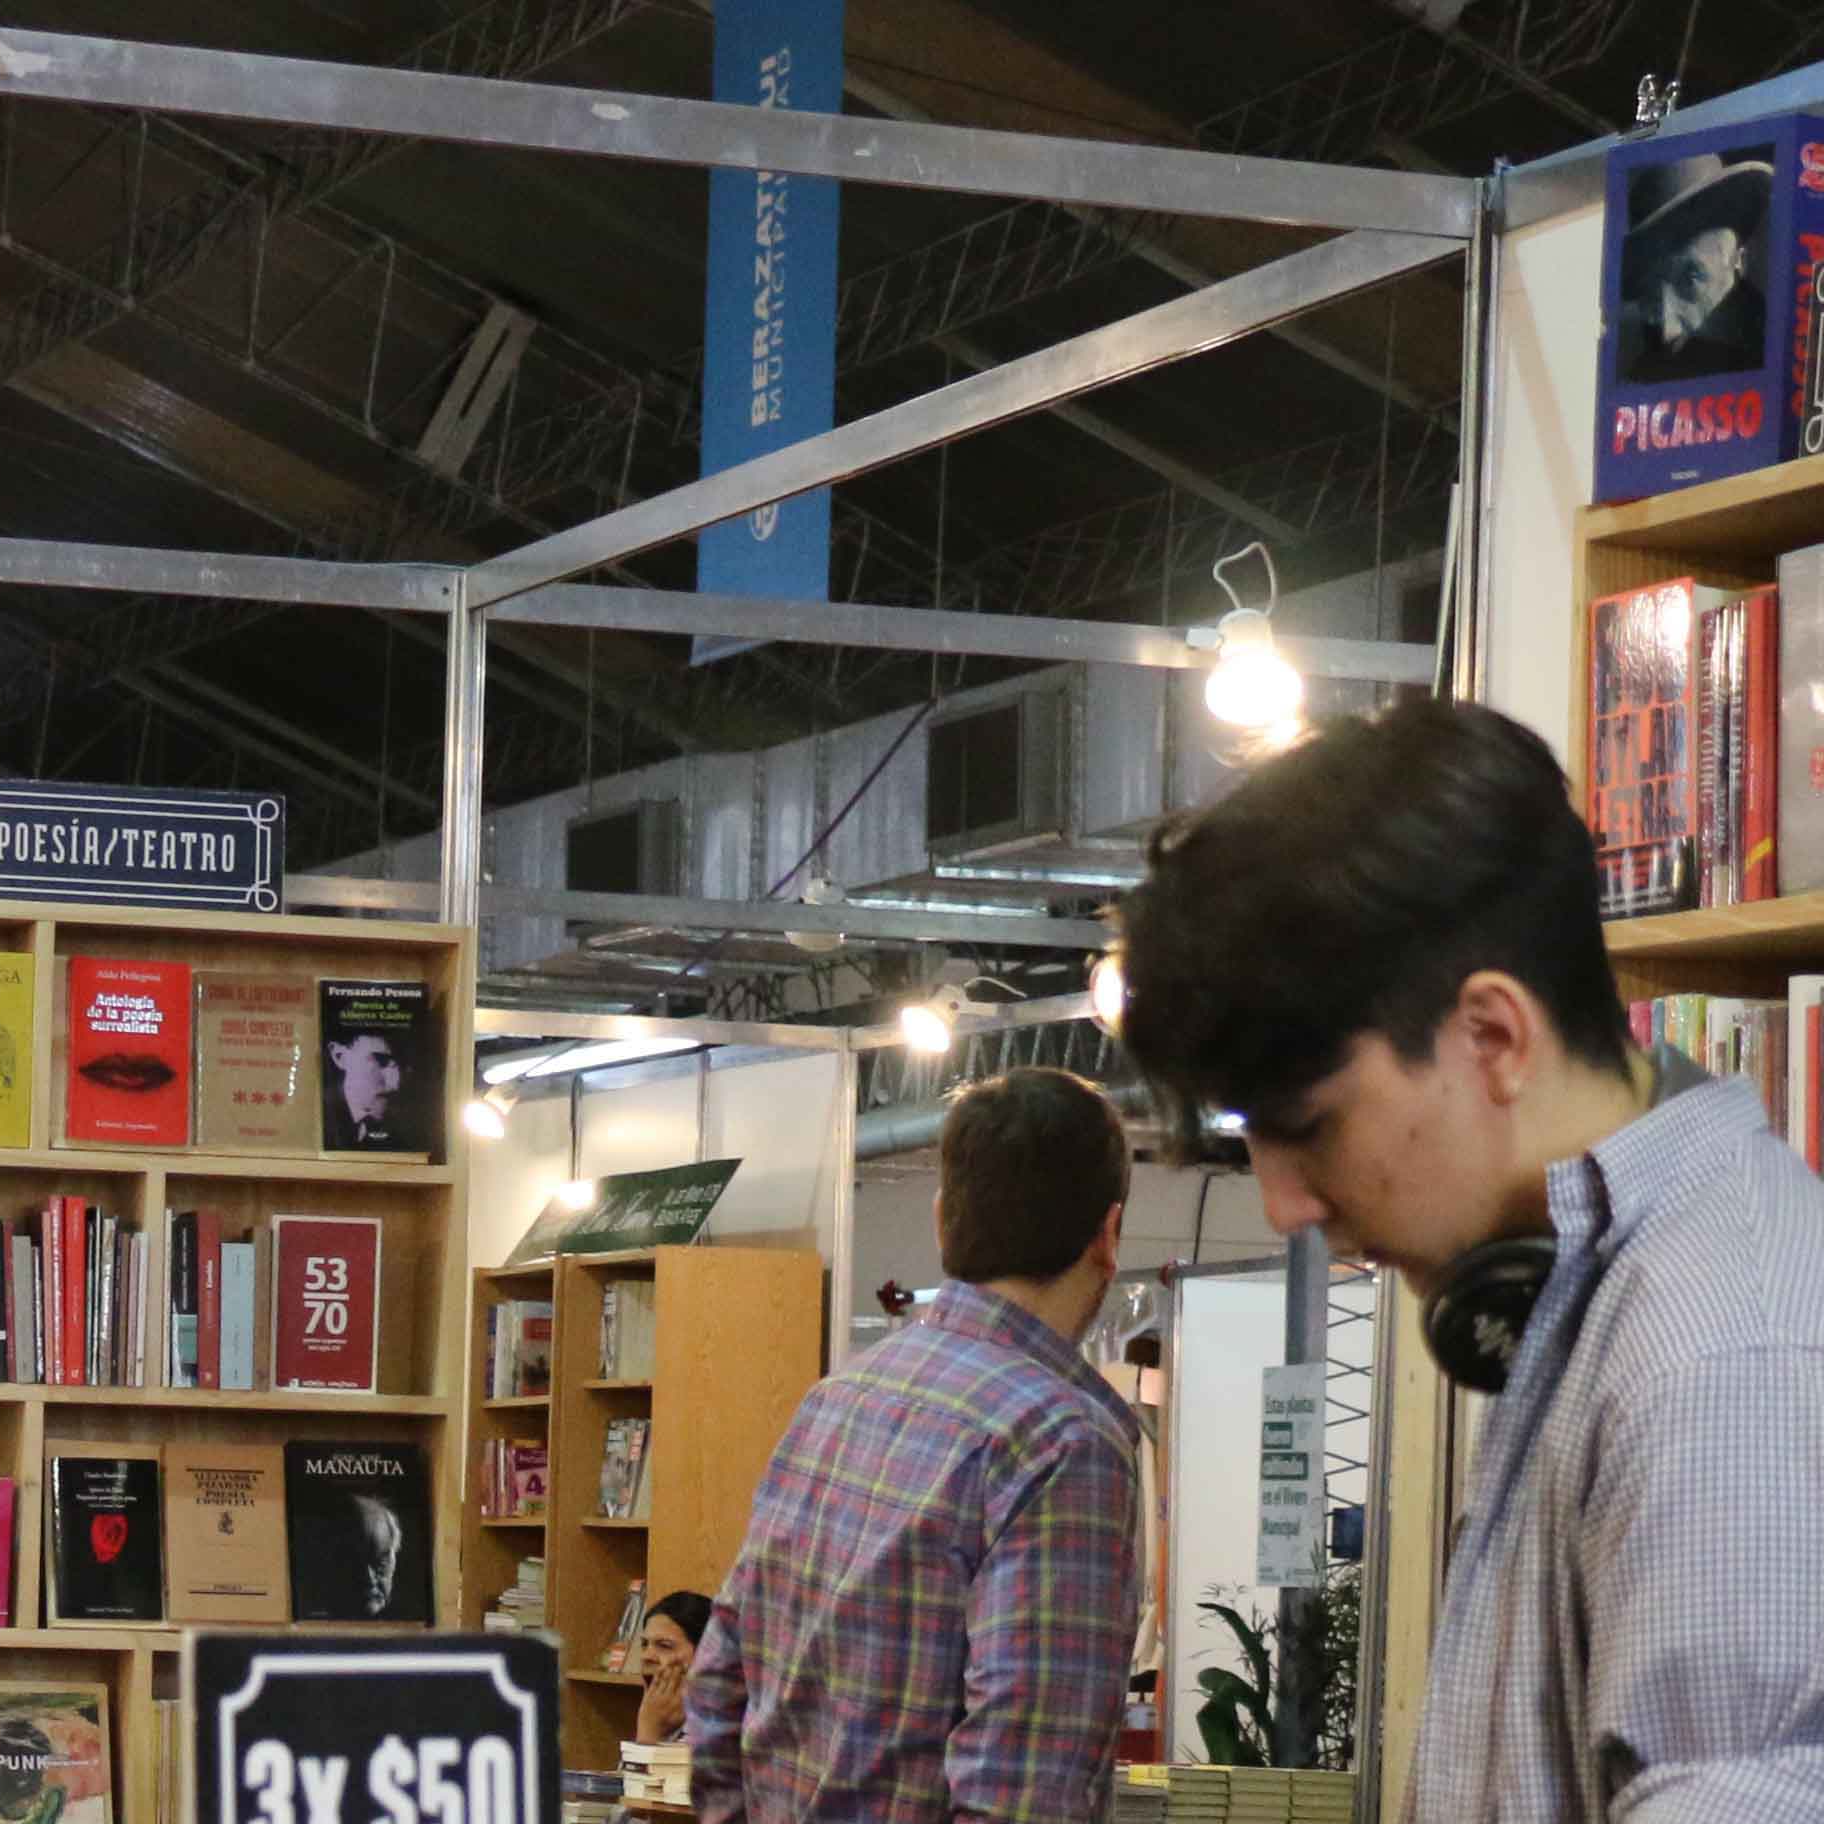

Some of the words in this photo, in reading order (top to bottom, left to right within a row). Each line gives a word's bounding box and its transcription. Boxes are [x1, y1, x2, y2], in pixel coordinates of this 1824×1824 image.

[751, 54, 778, 426] BERAZATUI
[1612, 389, 1764, 455] PICASSO
[328, 986, 381, 999] Fernando
[304, 1256, 350, 1291] 53
[303, 1300, 350, 1335] 70
[305, 1457, 405, 1477] MANAUTA
